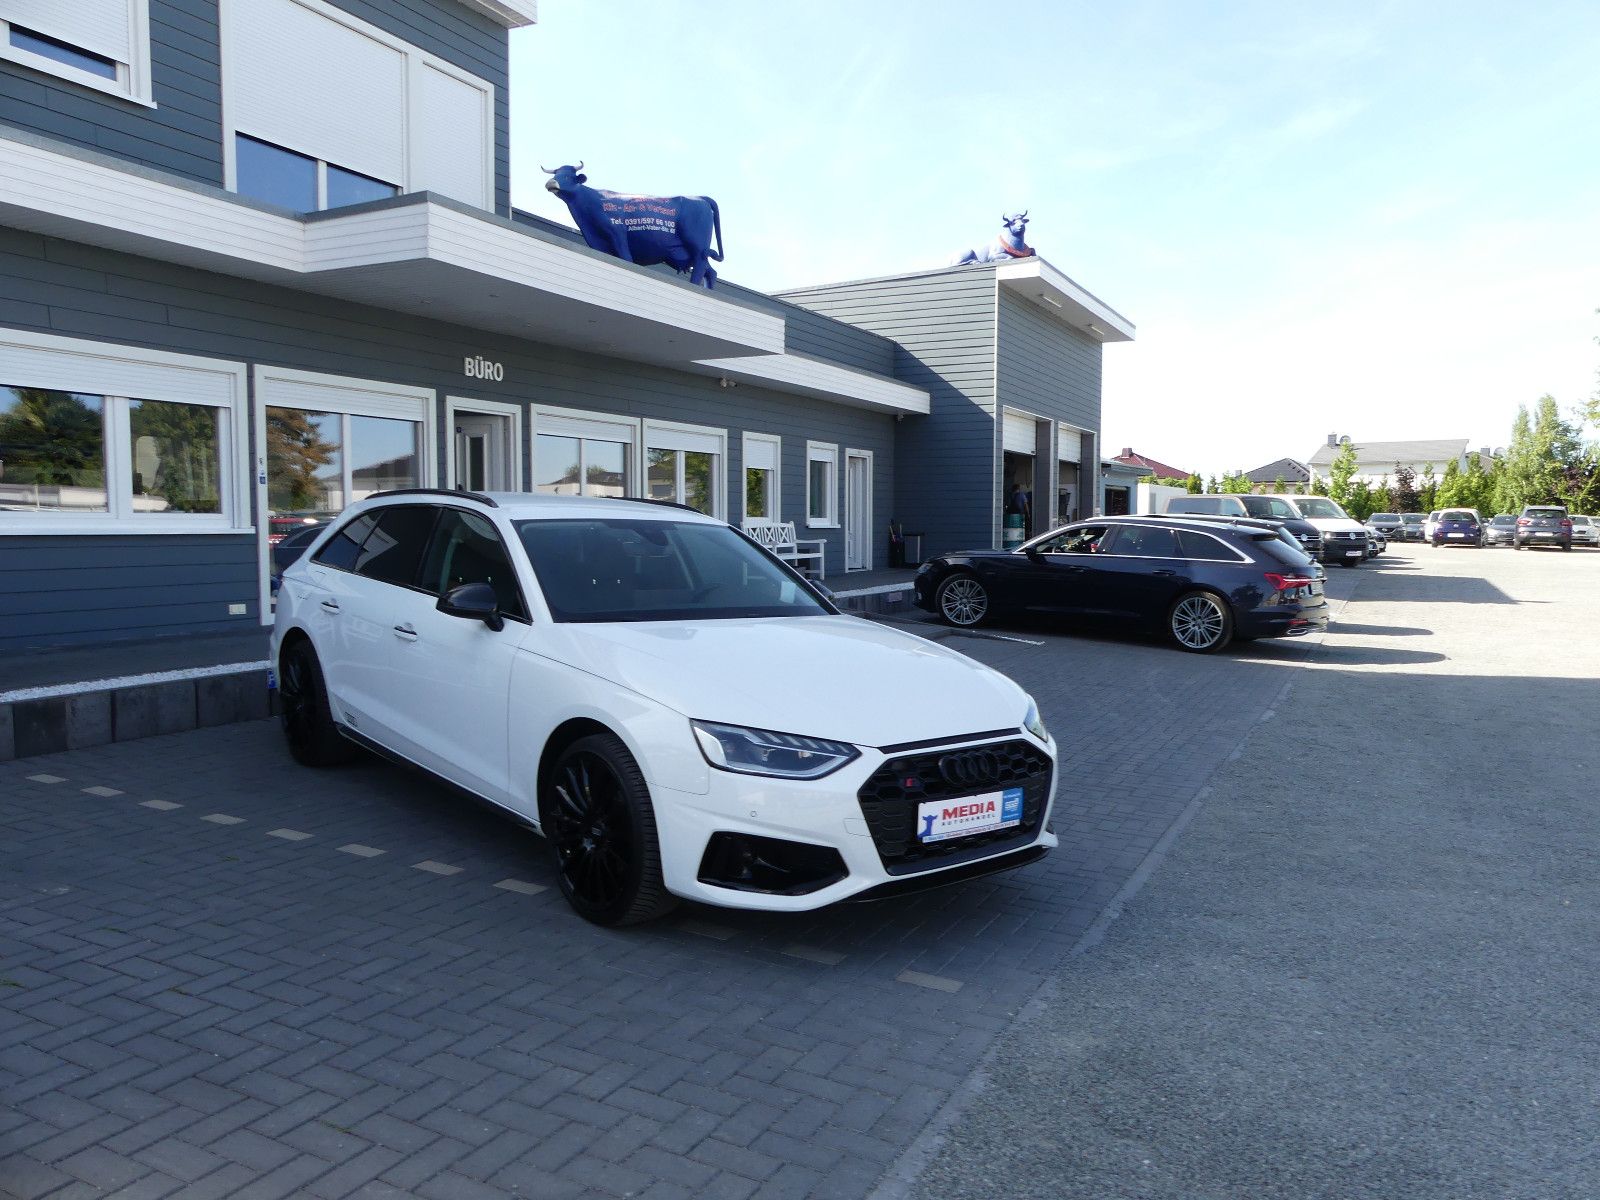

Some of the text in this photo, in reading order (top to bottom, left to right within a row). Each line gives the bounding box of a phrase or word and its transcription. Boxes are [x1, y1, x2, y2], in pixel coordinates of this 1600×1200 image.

[625, 218, 654, 226] 0391/597
[464, 355, 504, 382] BÜRO
[942, 800, 996, 821] MEDIA
[941, 813, 996, 826] AUTOHANDEL
